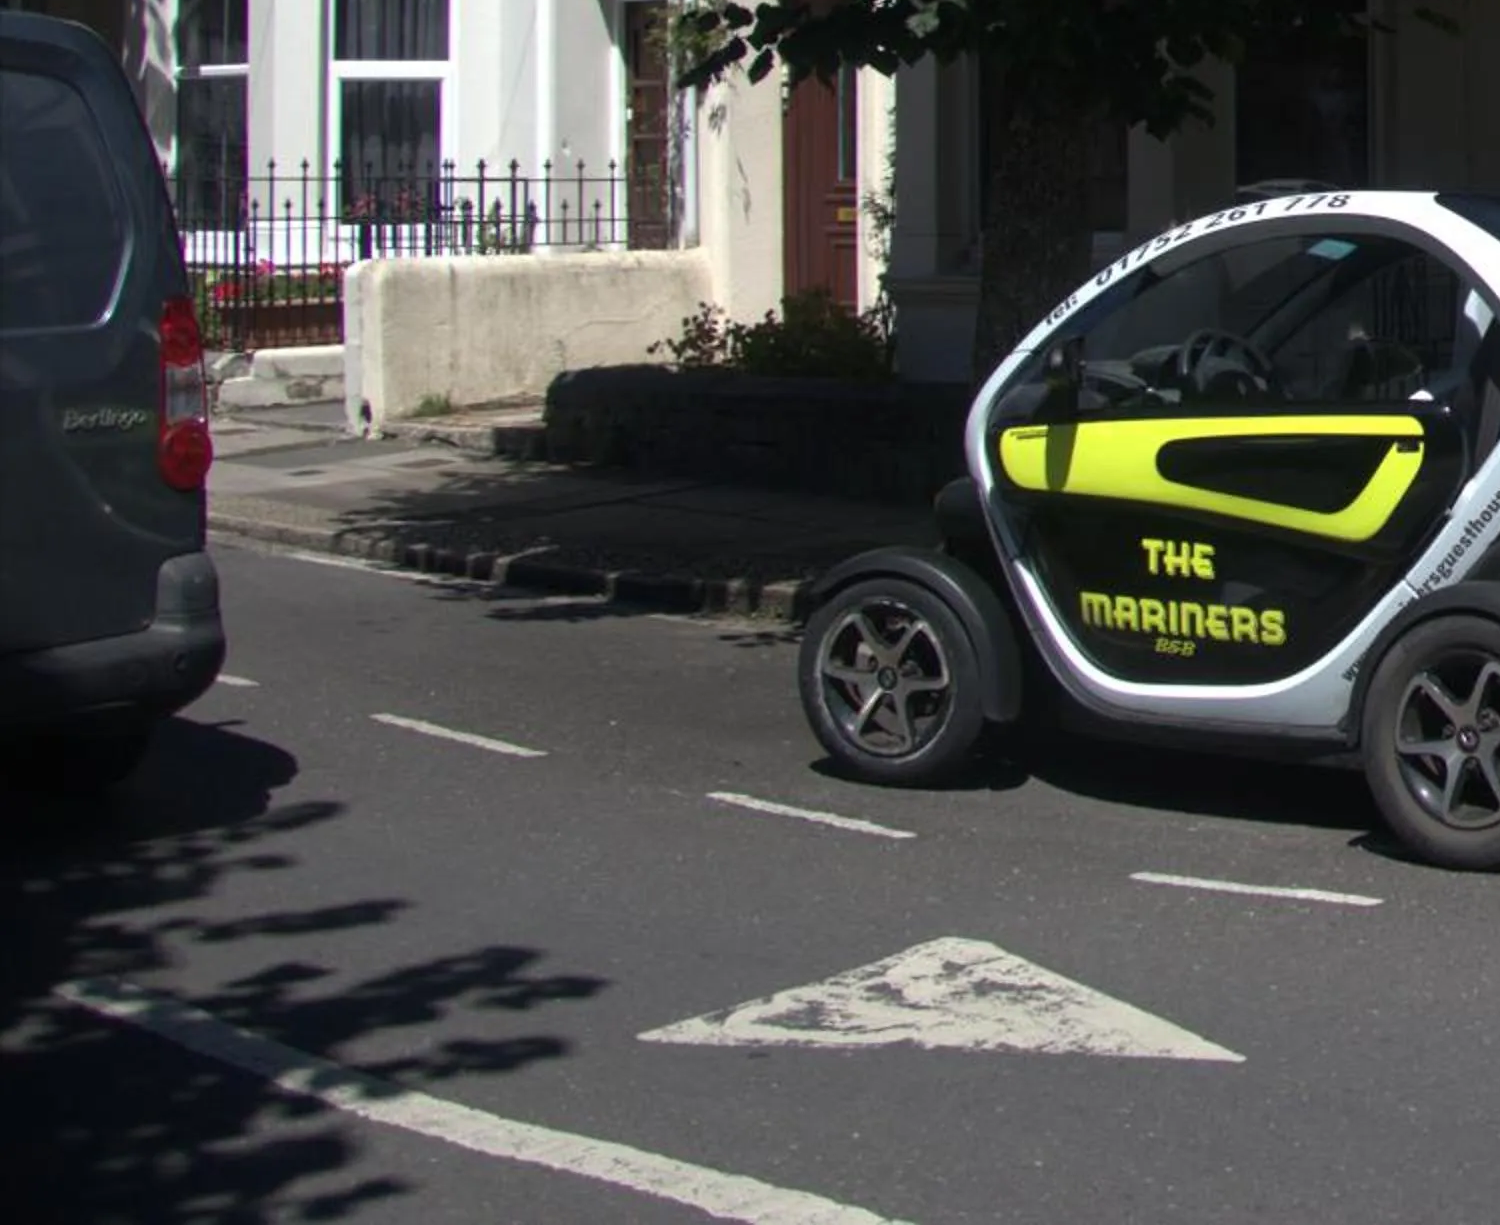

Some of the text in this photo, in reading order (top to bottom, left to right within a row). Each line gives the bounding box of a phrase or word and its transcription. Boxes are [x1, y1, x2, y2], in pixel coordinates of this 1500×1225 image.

[1096, 223, 1194, 287] 01752
[1204, 202, 1268, 229] 261
[1284, 194, 1351, 211] 778
[1141, 538, 1216, 580] THE
[1079, 591, 1288, 646] MARINERS
